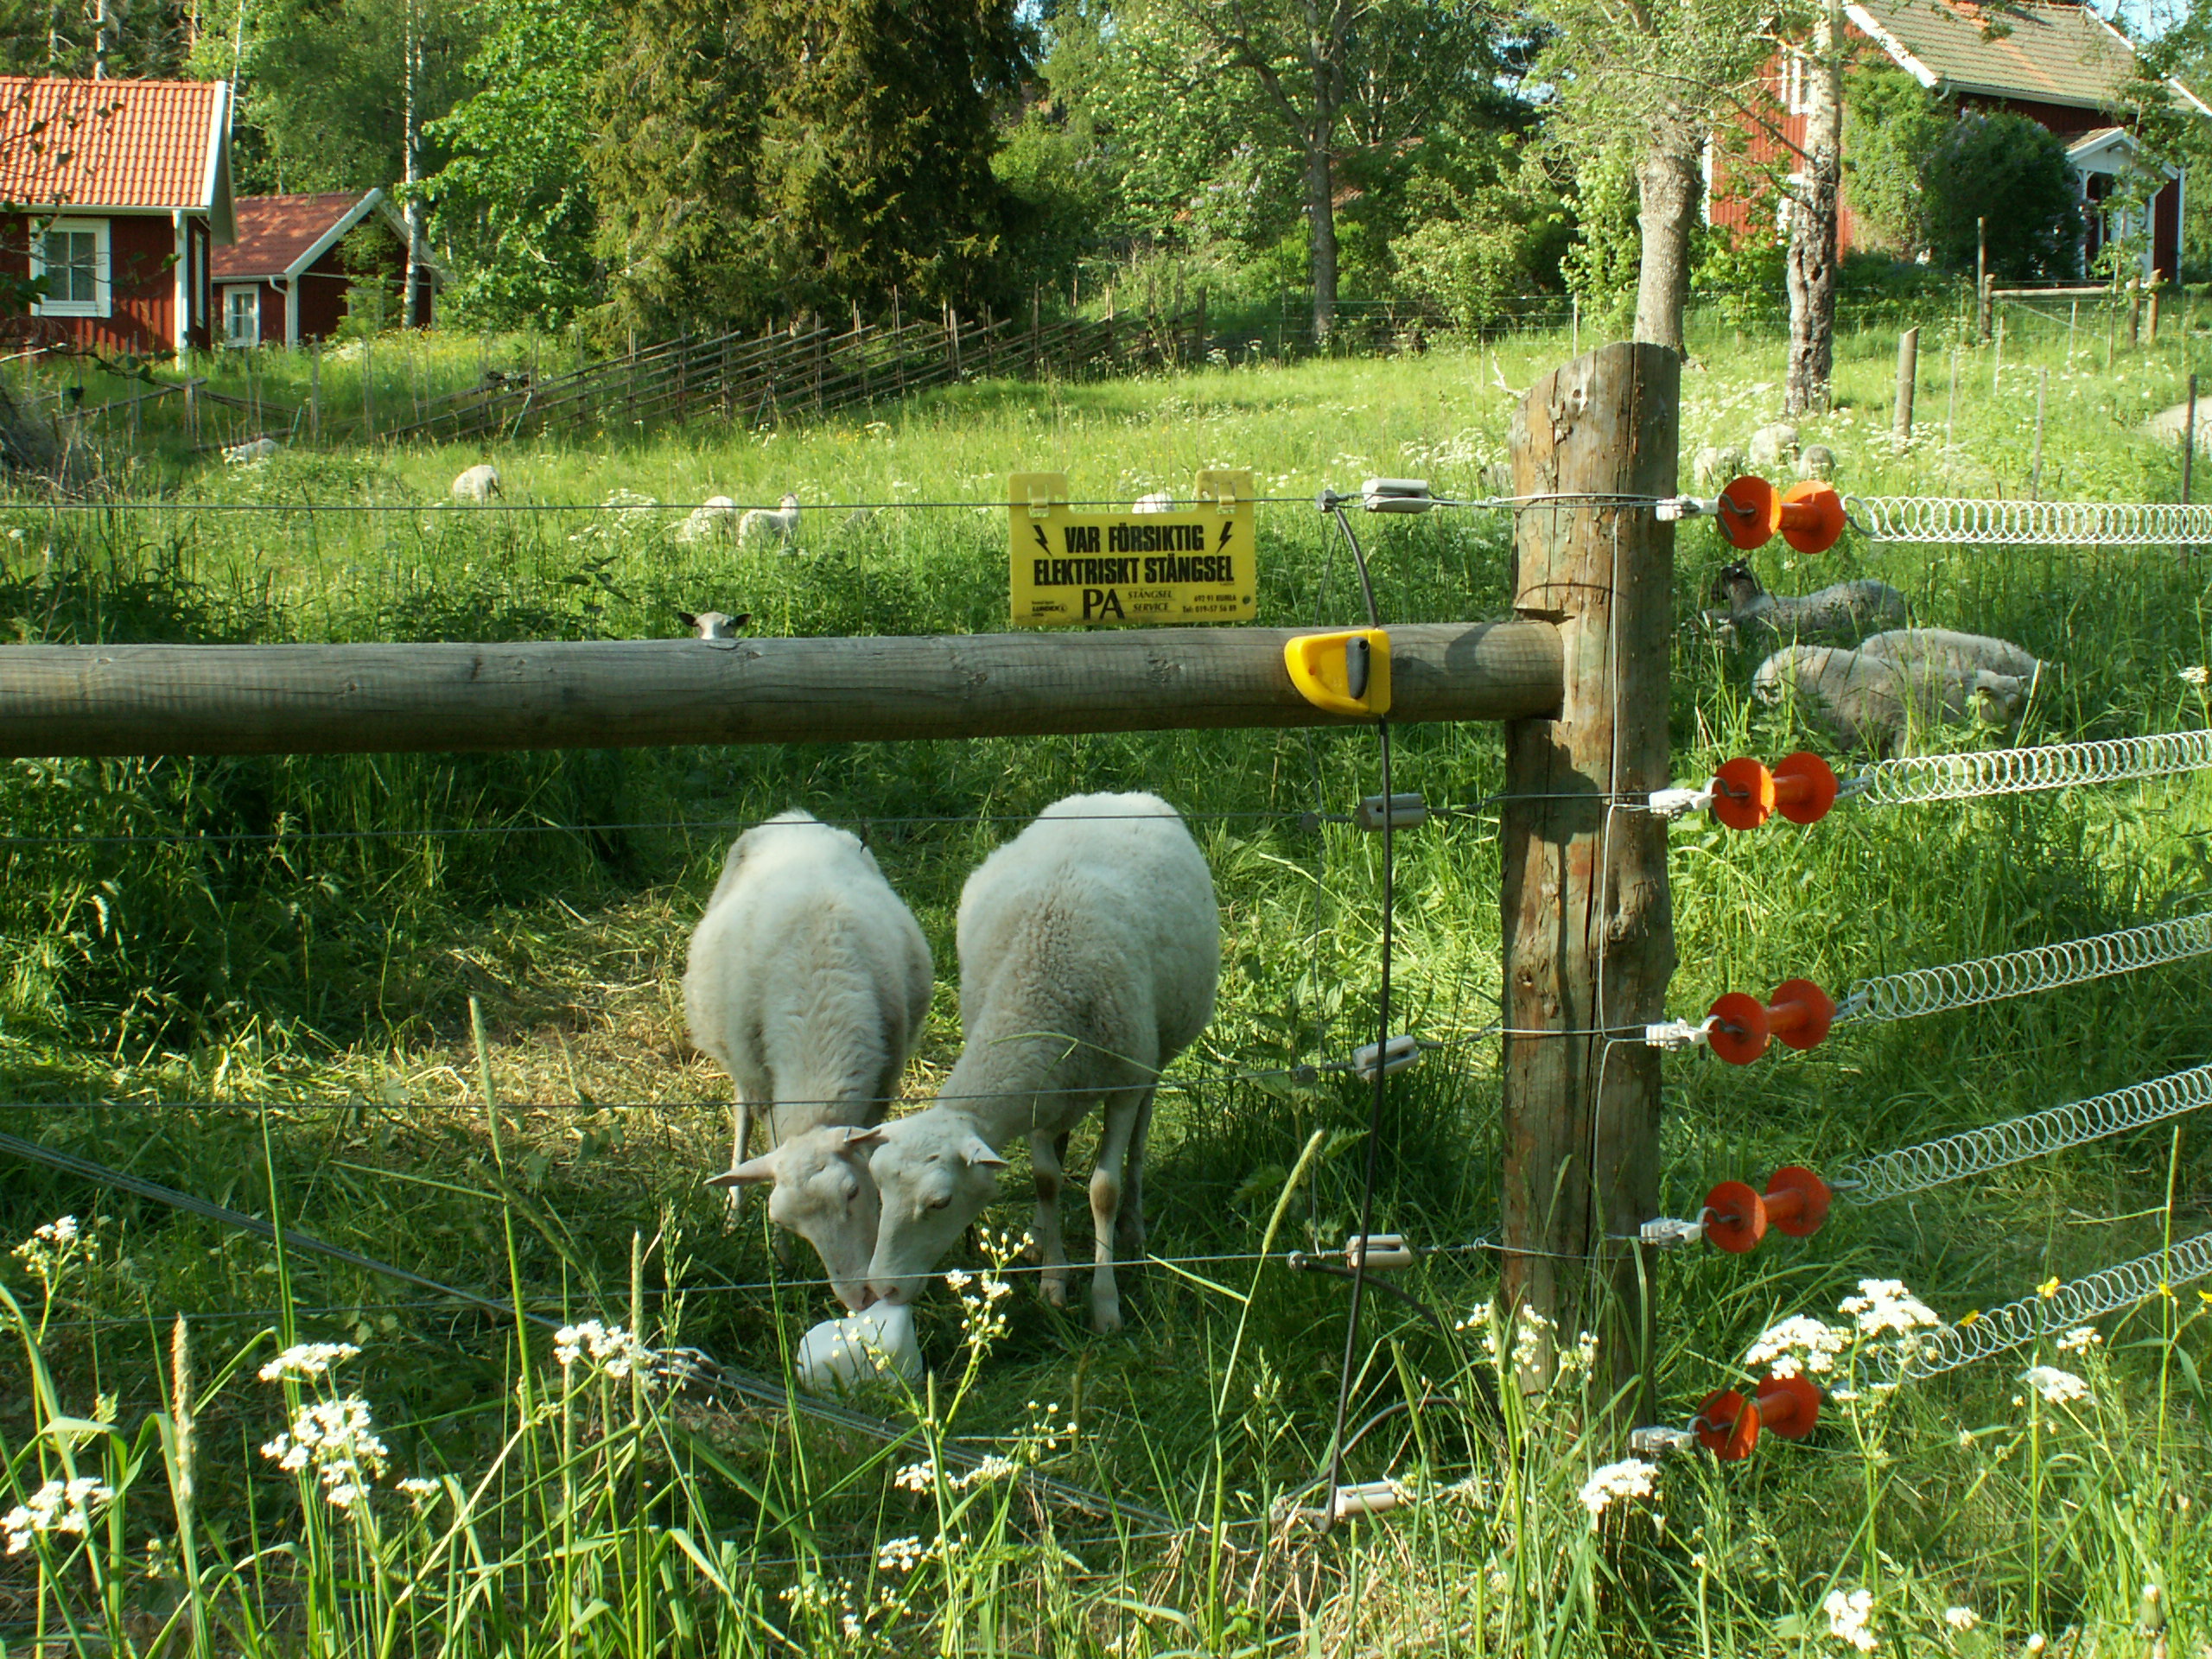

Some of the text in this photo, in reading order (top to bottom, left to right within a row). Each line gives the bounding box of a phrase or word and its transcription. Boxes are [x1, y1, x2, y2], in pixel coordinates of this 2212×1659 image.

[1065, 523, 1205, 553] VAR FÖRSIKTIG
[1033, 553, 1235, 586] ELEKTRISKT STÄNGSEL
[1083, 588, 1125, 620] PA
[1133, 602, 1169, 613] SERVICE
